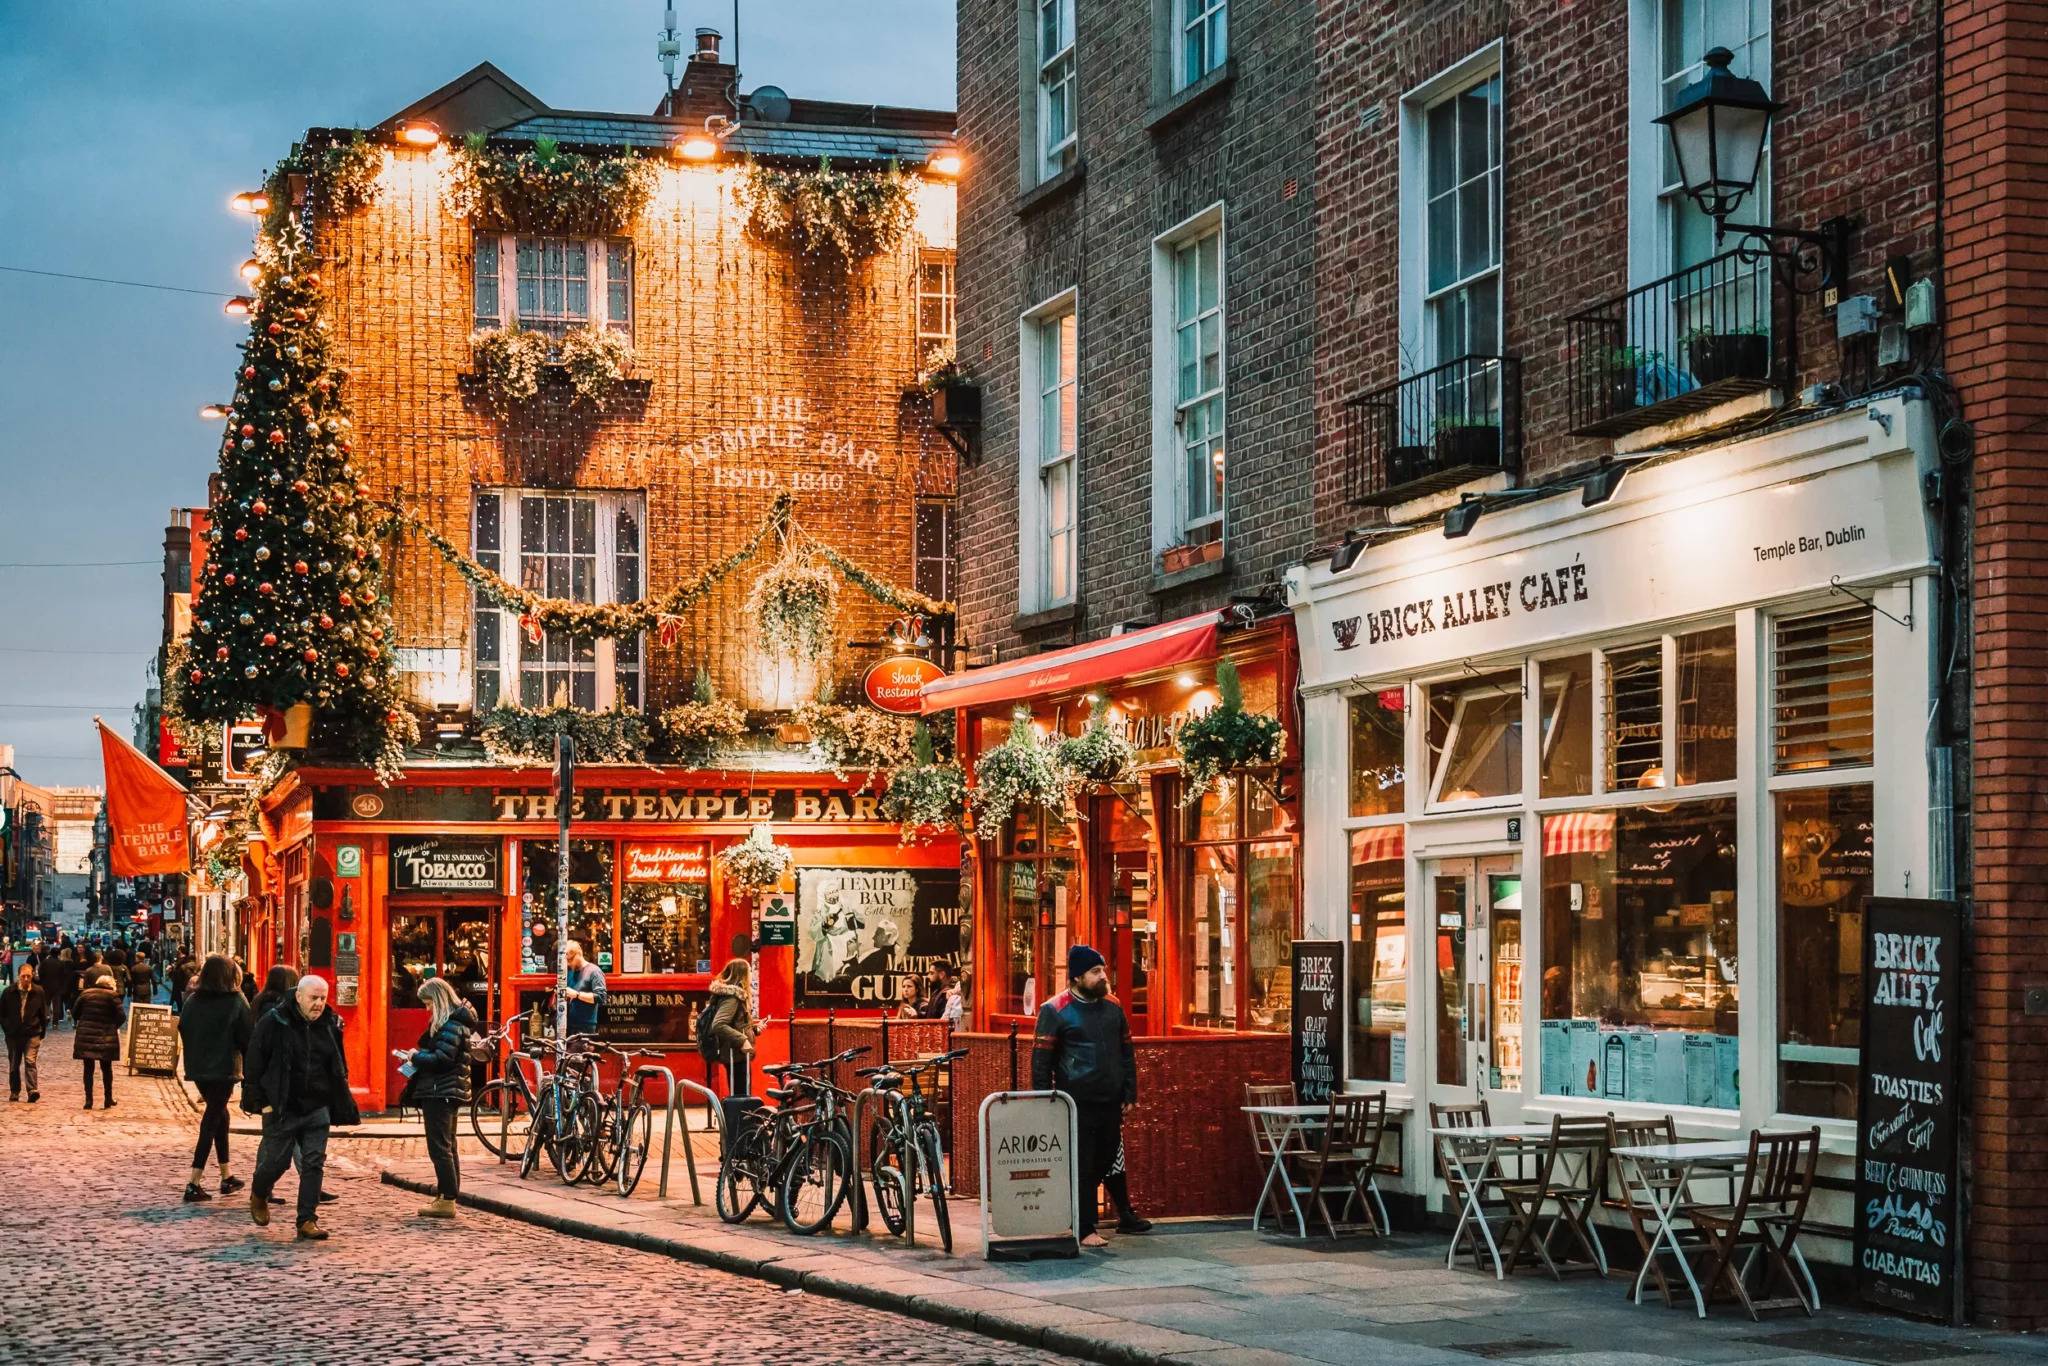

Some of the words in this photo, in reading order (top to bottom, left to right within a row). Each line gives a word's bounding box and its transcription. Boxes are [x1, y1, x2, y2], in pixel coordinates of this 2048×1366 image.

[752, 397, 812, 420] THE
[680, 423, 806, 467] TEMPLE
[820, 432, 880, 475] BAR
[791, 472, 845, 491] 1840
[1753, 541, 1796, 562] Temple
[1798, 537, 1822, 552] Bar,
[1825, 525, 1865, 547] Dublin
[1367, 599, 1435, 645] BRICK
[1442, 581, 1512, 629] ALLEY
[1519, 552, 1588, 612] CAFÉ
[892, 667, 922, 685] Shack
[1710, 725, 1737, 739] CAF
[359, 799, 377, 812] 48
[494, 796, 585, 820] THE
[602, 796, 774, 820] TEMPLE
[791, 796, 880, 820] BAR
[137, 822, 165, 833] THE
[120, 829, 183, 847] TEMPLE
[138, 844, 171, 858] BAR
[393, 839, 439, 858] Importers
[433, 854, 451, 862] FINE
[451, 854, 486, 862] SMOKING
[630, 845, 704, 862] Traditional
[405, 857, 486, 885] TOBACCO
[627, 863, 662, 878] Irish
[667, 864, 707, 878] Music
[422, 879, 451, 888] Always
[468, 879, 493, 887] Stock
[836, 876, 912, 891] TEMPLE
[859, 891, 895, 907] BAR
[1873, 932, 1941, 972] BRICK
[1300, 956, 1333, 974] BRICK
[1300, 974, 1335, 992] ALLEY
[1873, 971, 1941, 1010] ALLEY
[603, 993, 652, 1006] EMPLE
[655, 994, 687, 1006] BAR
[1322, 988, 1336, 1011] Café
[607, 1007, 638, 1015] DUBLIN
[1304, 1016, 1327, 1033] CRAFT
[1913, 1000, 1945, 1063] Café
[1871, 1073, 1944, 1105] TOASTIES
[998, 1134, 1062, 1155] ARIOSA
[1907, 1120, 1935, 1152] Soup
[1865, 1160, 1888, 1184] BEEF
[1886, 1162, 1897, 1193] &
[1899, 1166, 1947, 1195] GUINNESS
[1866, 1194, 1947, 1248] SALADS
[1883, 1217, 1925, 1242] Paninis
[1862, 1248, 1941, 1288] CIABATTAS
